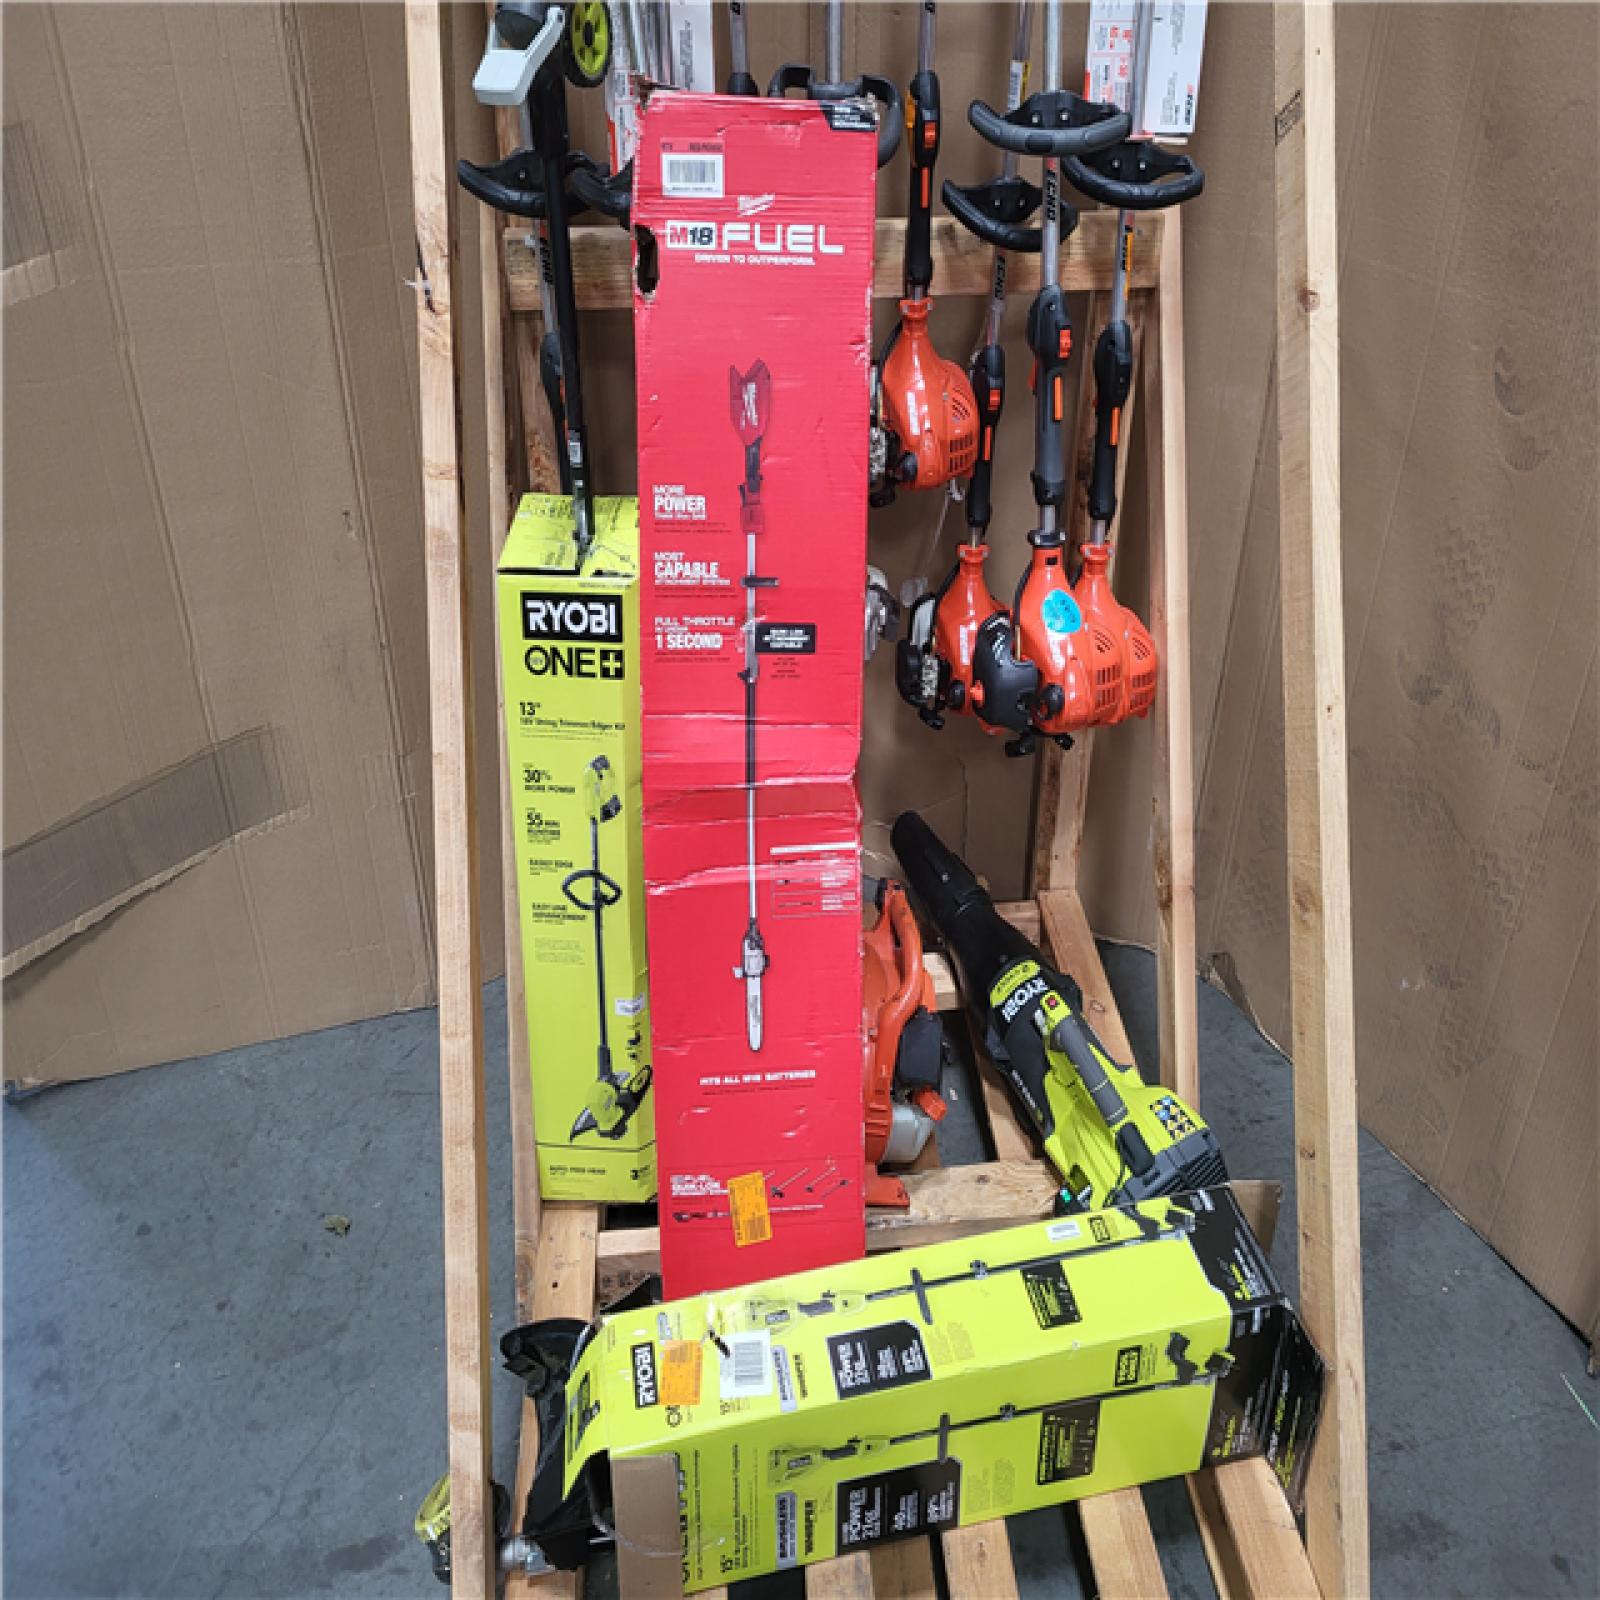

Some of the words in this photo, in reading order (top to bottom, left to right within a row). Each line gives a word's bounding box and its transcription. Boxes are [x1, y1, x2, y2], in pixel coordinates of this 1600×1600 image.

[1046, 169, 1056, 222] ECHO
[669, 224, 714, 247] M18
[721, 222, 844, 254] FUEL
[653, 484, 686, 494] MORE
[654, 496, 706, 512] POWER
[654, 561, 719, 579] CAPABLE
[525, 599, 618, 636] RYOBI
[654, 616, 679, 626] FULL
[681, 616, 735, 626] THROTTLE
[655, 634, 664, 649] 1
[666, 633, 724, 649] SECOND
[1002, 976, 1049, 1023] RYOBI
[723, 1075, 741, 1084] ALL
[634, 1346, 657, 1406] RYOBI
